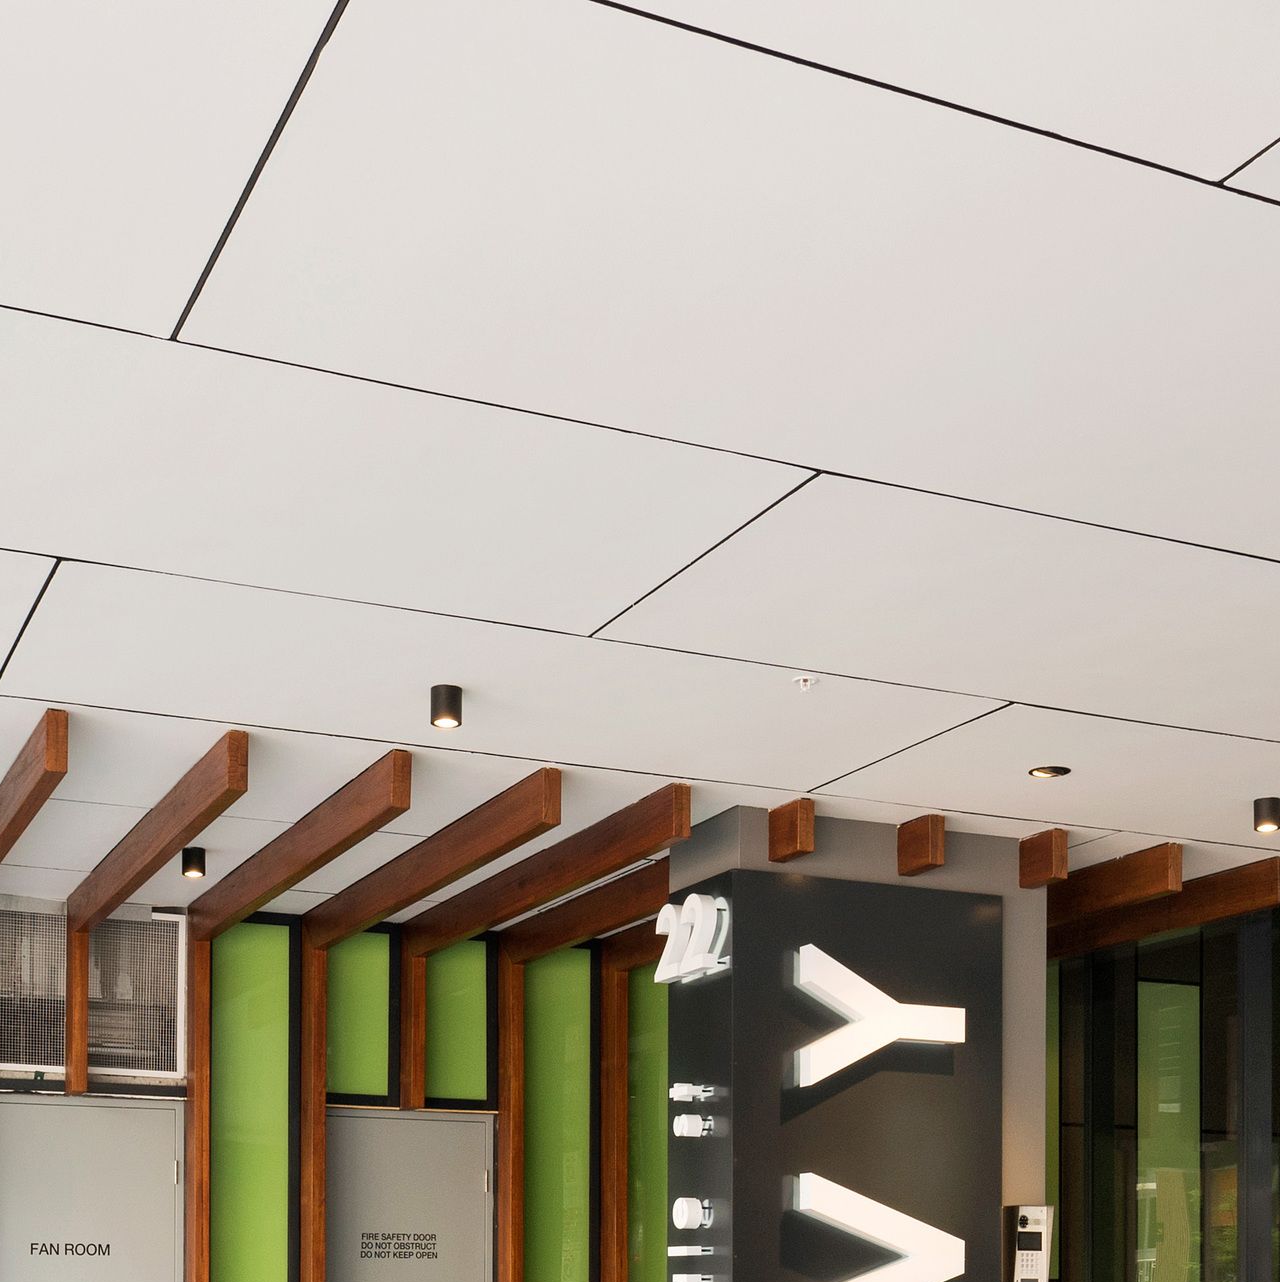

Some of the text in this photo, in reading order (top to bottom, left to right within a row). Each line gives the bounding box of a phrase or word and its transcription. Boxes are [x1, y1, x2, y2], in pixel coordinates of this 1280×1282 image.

[654, 893, 730, 983] 22
[669, 1082, 714, 1137] st
[361, 1233, 437, 1242] FIRE SAFETY DOOR
[30, 1243, 110, 1256] FAN ROOM
[361, 1242, 437, 1250] DO NOT OBSTRUCT
[360, 1250, 438, 1260] DO NOT KEEP OPEN
